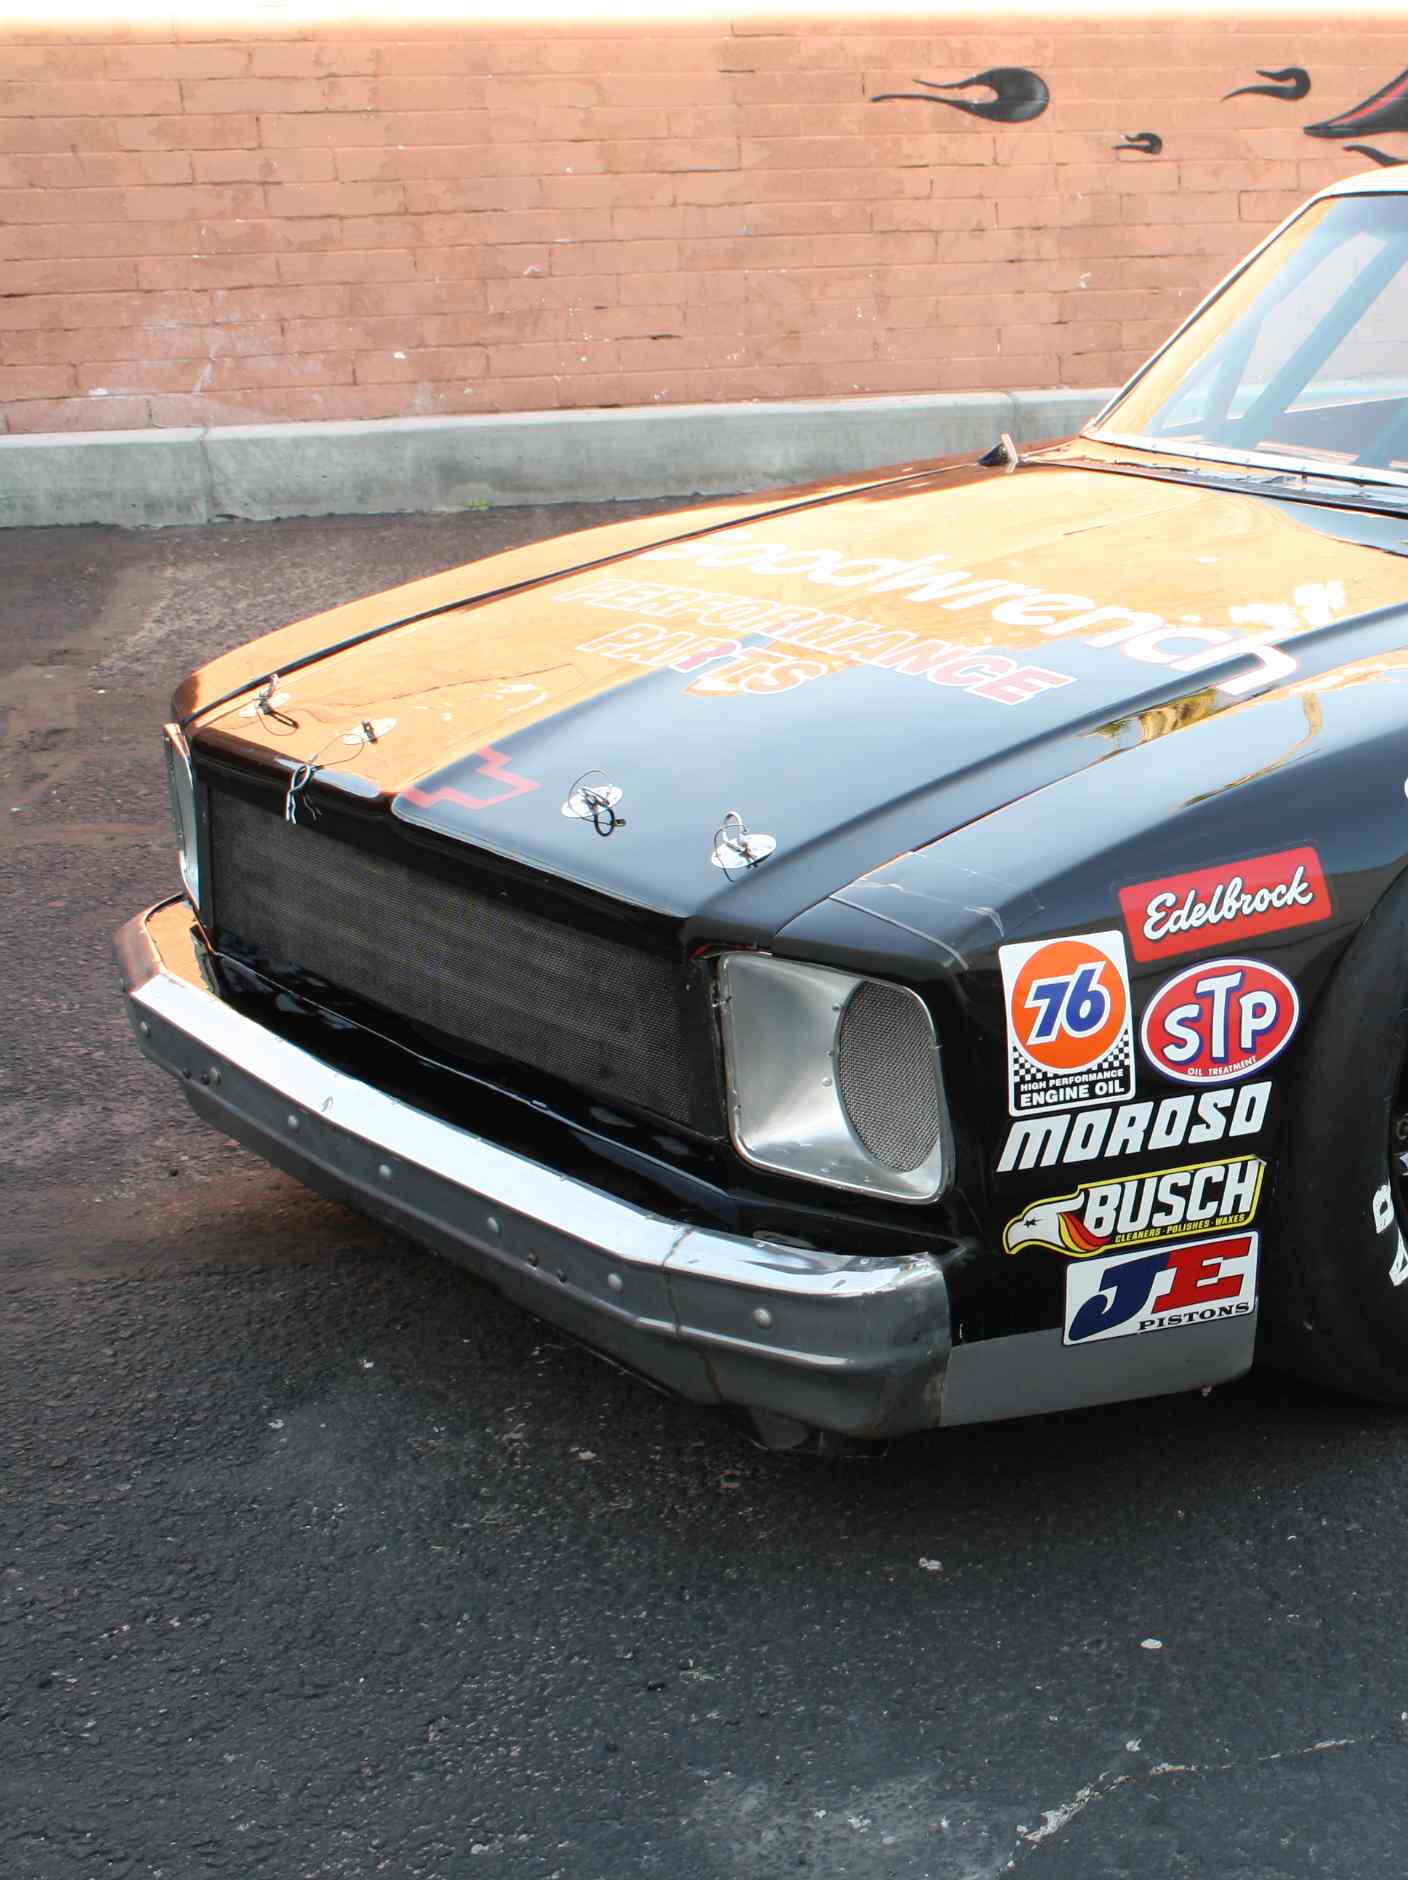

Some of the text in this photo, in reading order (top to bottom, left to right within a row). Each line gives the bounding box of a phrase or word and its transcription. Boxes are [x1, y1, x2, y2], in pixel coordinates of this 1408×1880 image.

[551, 578, 1078, 706] PERFORMANCE
[575, 623, 830, 696] PARTS
[1142, 864, 1314, 941] Edelbrock
[1023, 961, 1112, 1046] 76
[1162, 971, 1278, 1063] STP
[1020, 1068, 1125, 1093] HIGH PERFORMANCE
[1020, 1079, 1126, 1109] ENGINE OIL
[1187, 1055, 1258, 1077] OIL TREATMENT
[996, 1080, 1273, 1173] MOROSO
[1083, 1159, 1257, 1238] BUSCH
[1114, 1213, 1246, 1244] CLEANERS POLISHES WAXES
[1068, 1236, 1253, 1341] JE
[1138, 1301, 1251, 1332] PISTONS
